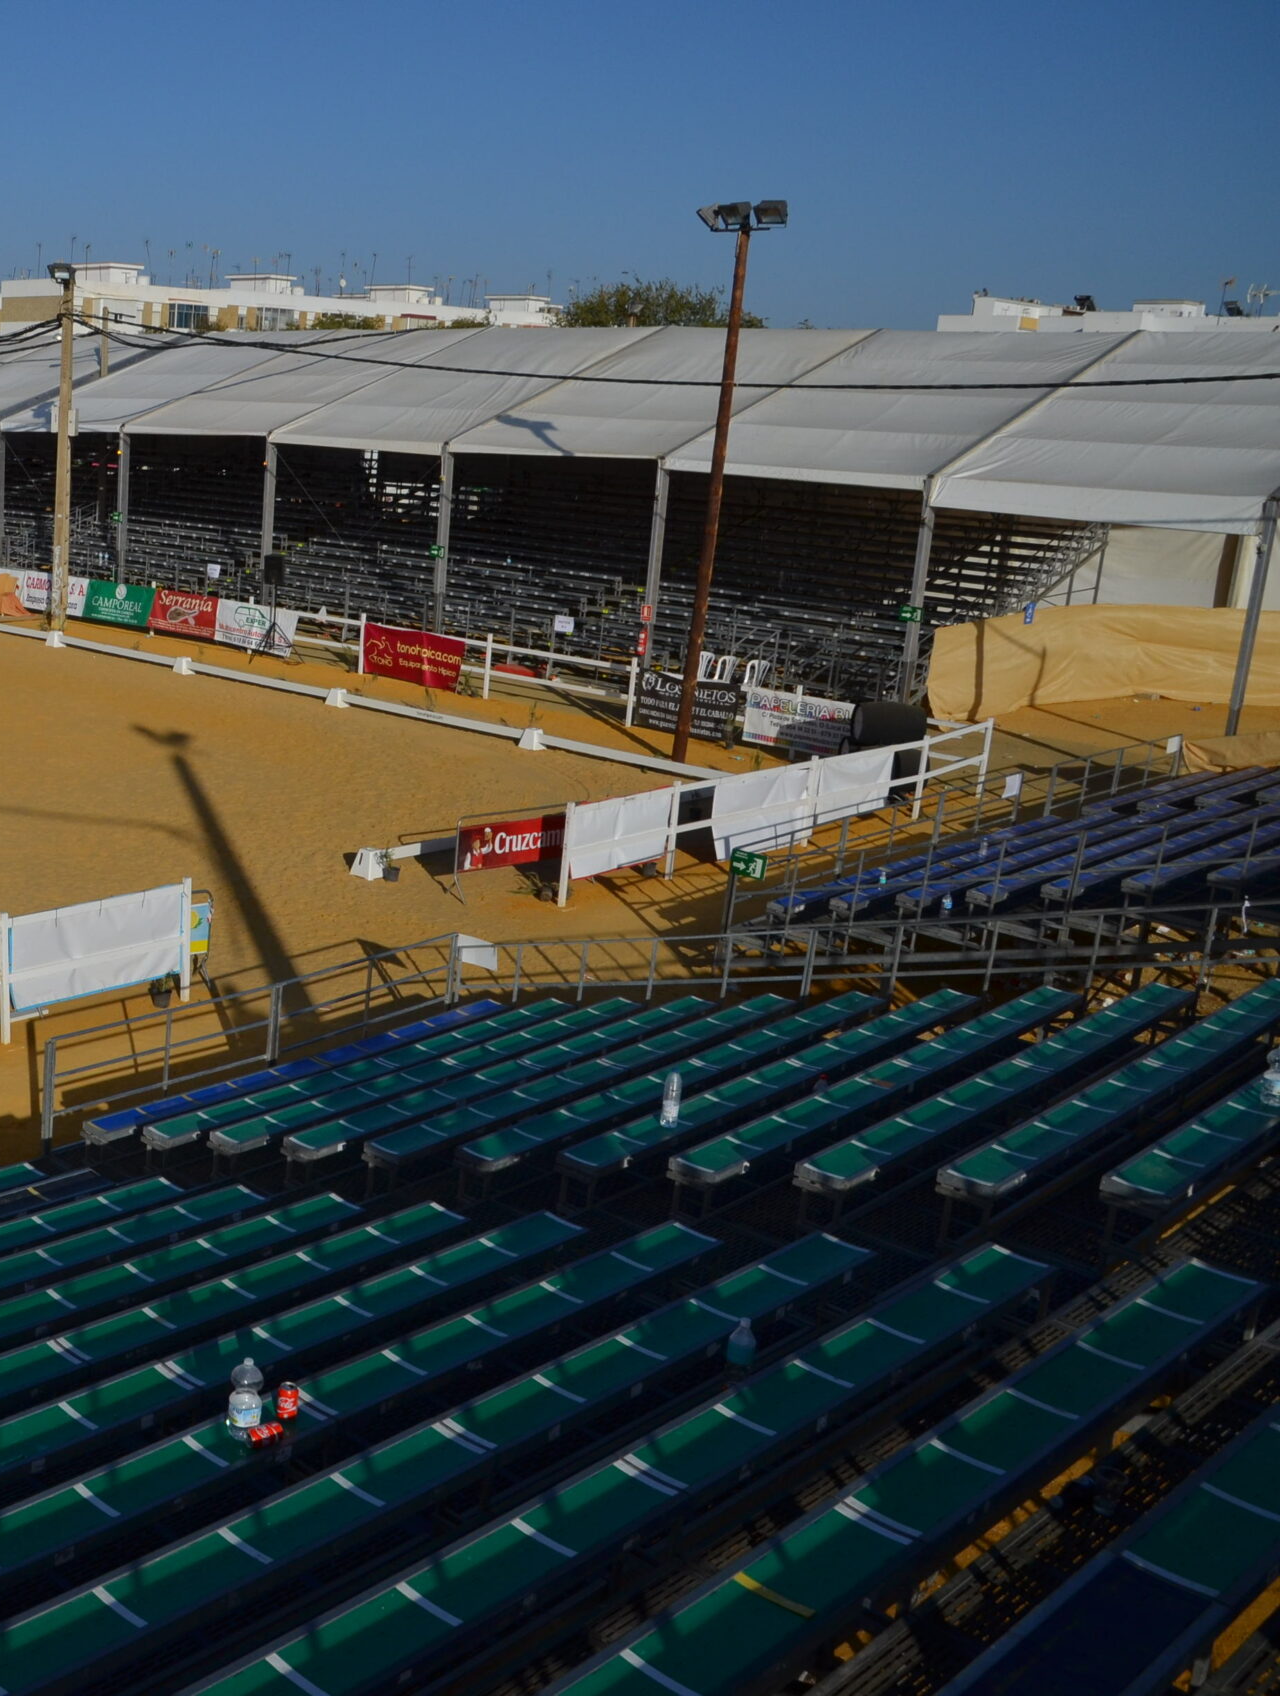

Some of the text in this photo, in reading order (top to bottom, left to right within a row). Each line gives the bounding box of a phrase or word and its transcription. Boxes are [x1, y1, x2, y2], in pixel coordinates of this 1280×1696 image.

[91, 595, 142, 613] CAMPOREAL
[159, 589, 213, 612] Serranía
[245, 616, 267, 627] EXPER
[750, 693, 830, 718] PAPELERIA
